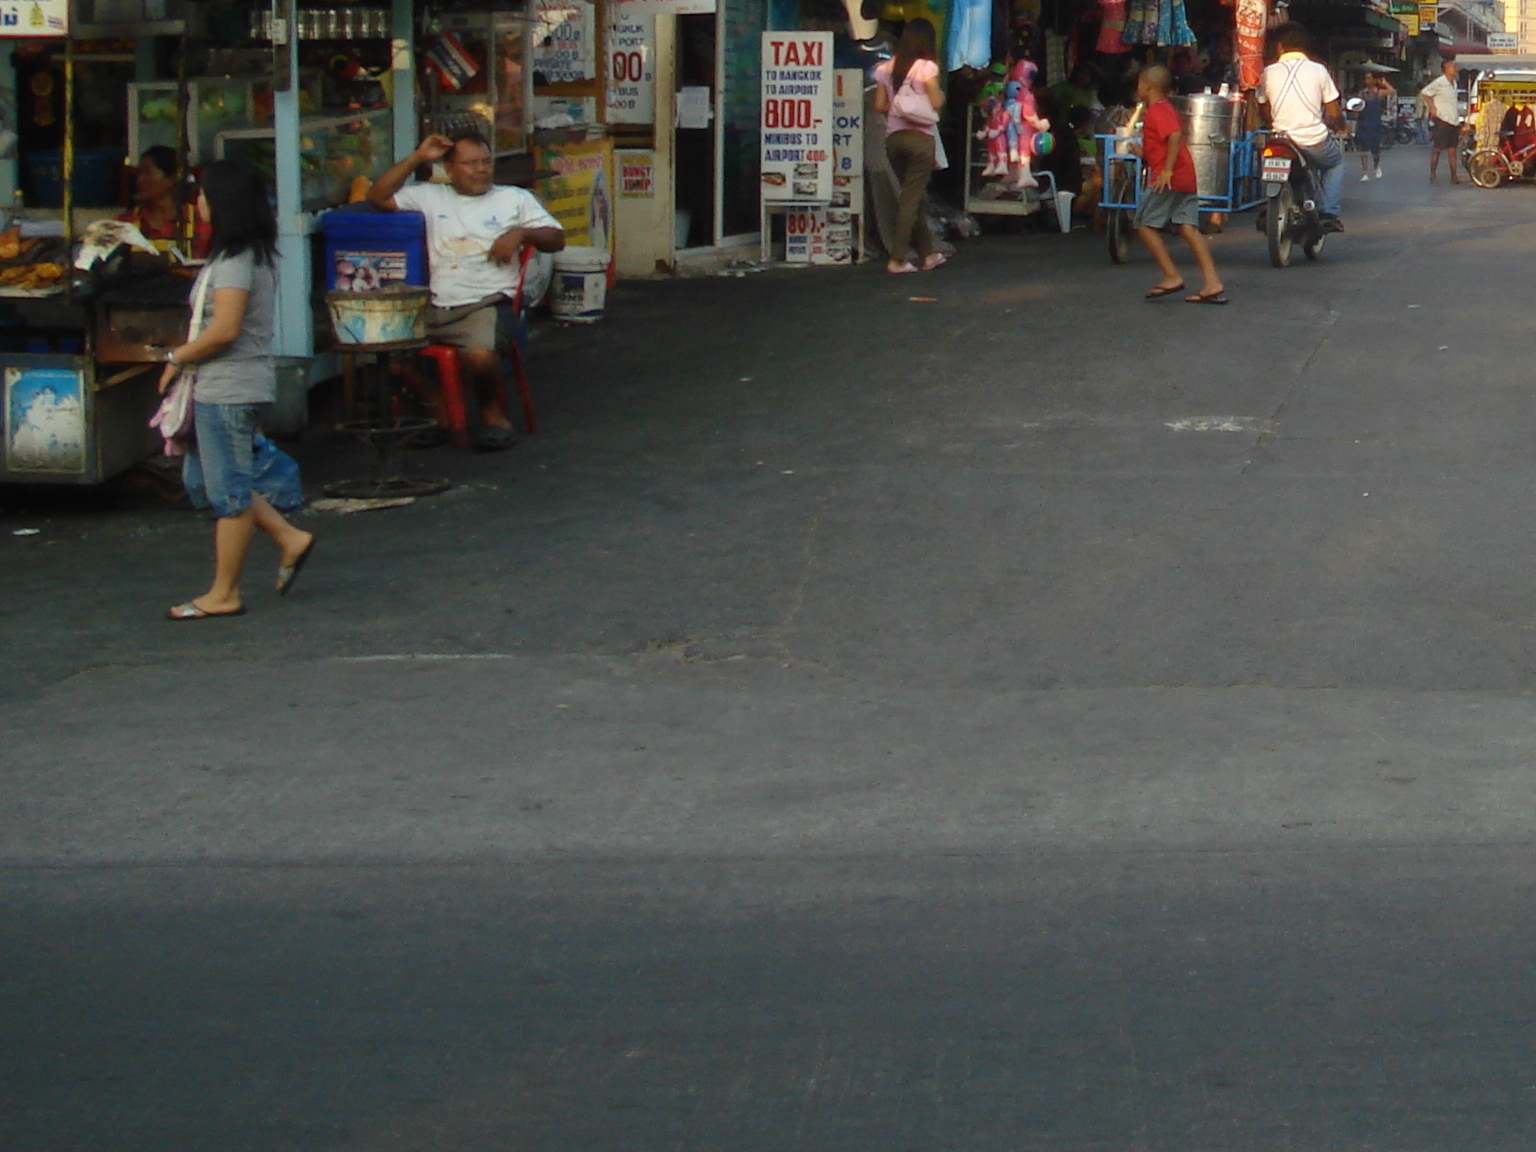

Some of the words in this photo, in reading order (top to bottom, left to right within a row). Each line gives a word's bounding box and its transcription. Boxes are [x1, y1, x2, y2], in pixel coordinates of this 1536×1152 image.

[770, 41, 823, 67] TAXI
[765, 70, 777, 81] TO
[779, 70, 822, 81] BANGKOK
[765, 84, 777, 96] TO
[778, 84, 819, 96] AIRPORT
[764, 132, 803, 146] MINIBUS
[806, 132, 818, 146] TO
[764, 148, 805, 163] AIRPORT
